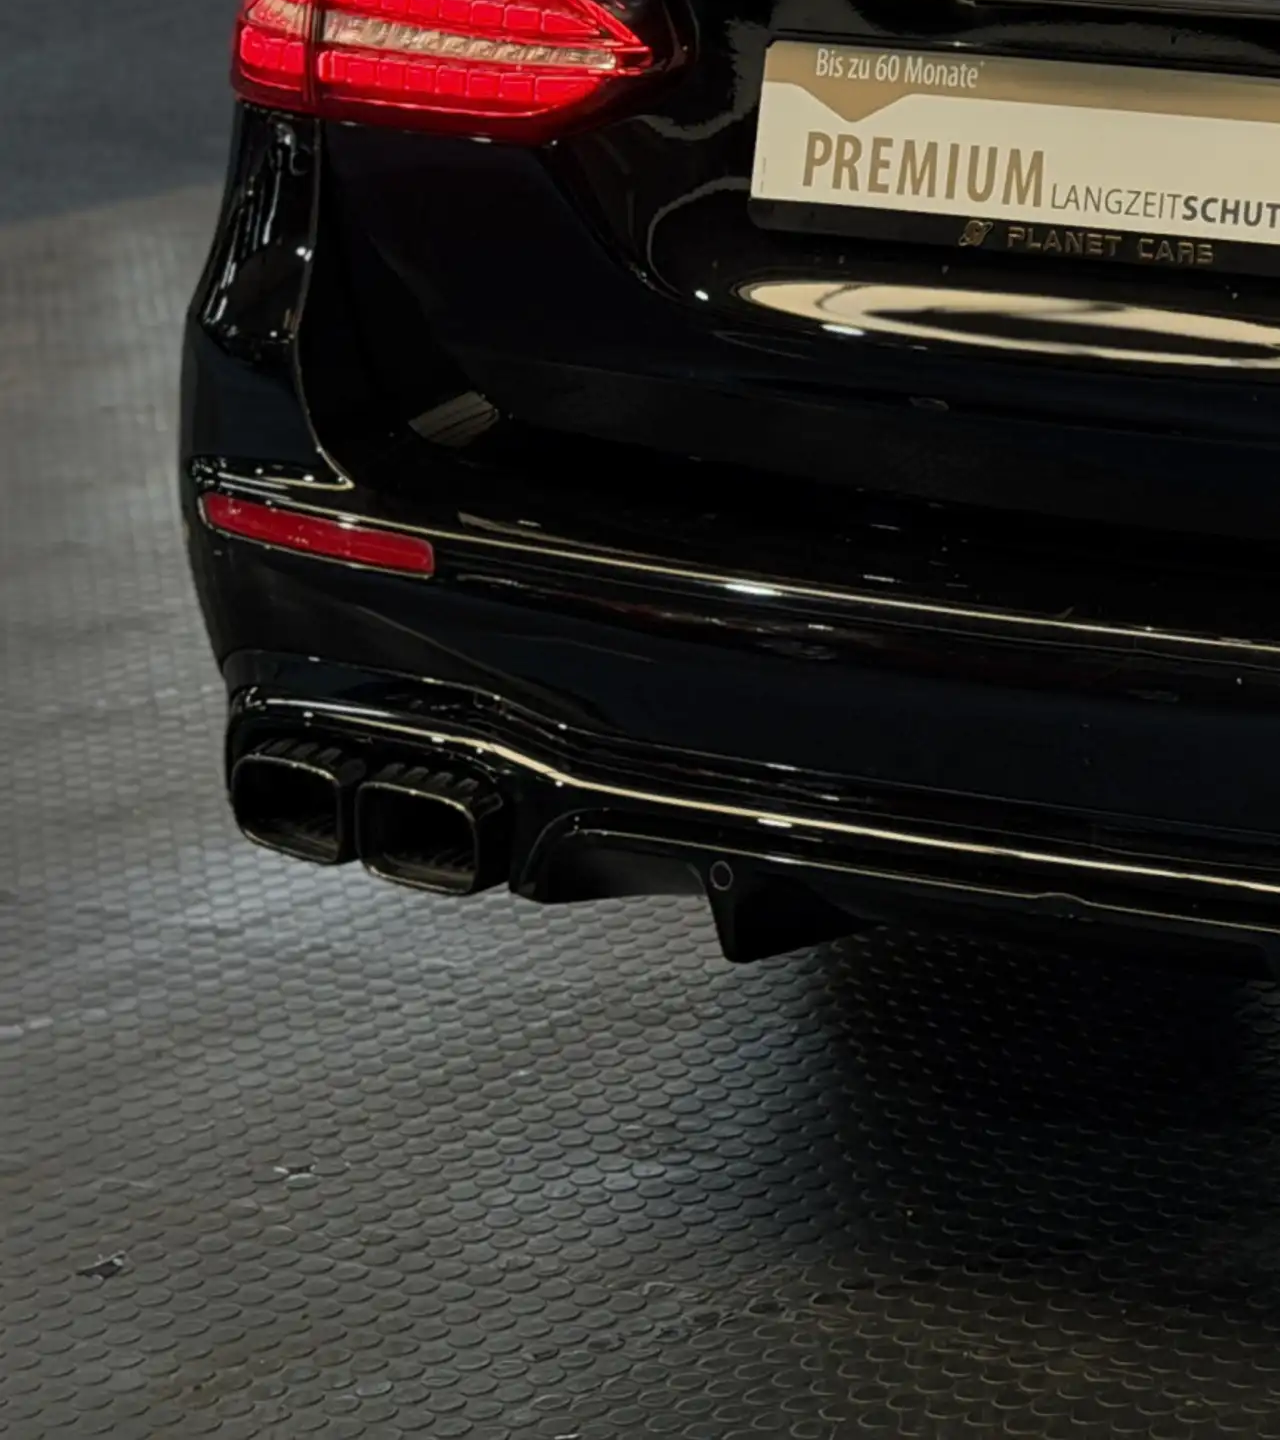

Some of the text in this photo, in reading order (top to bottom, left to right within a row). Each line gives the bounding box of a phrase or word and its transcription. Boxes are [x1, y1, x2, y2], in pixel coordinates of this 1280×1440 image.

[815, 48, 843, 77] Bis
[848, 57, 870, 80] zu
[875, 54, 900, 83] 60
[802, 131, 1044, 208] PREMIUM
[1007, 226, 1214, 265] PLANET CARS
